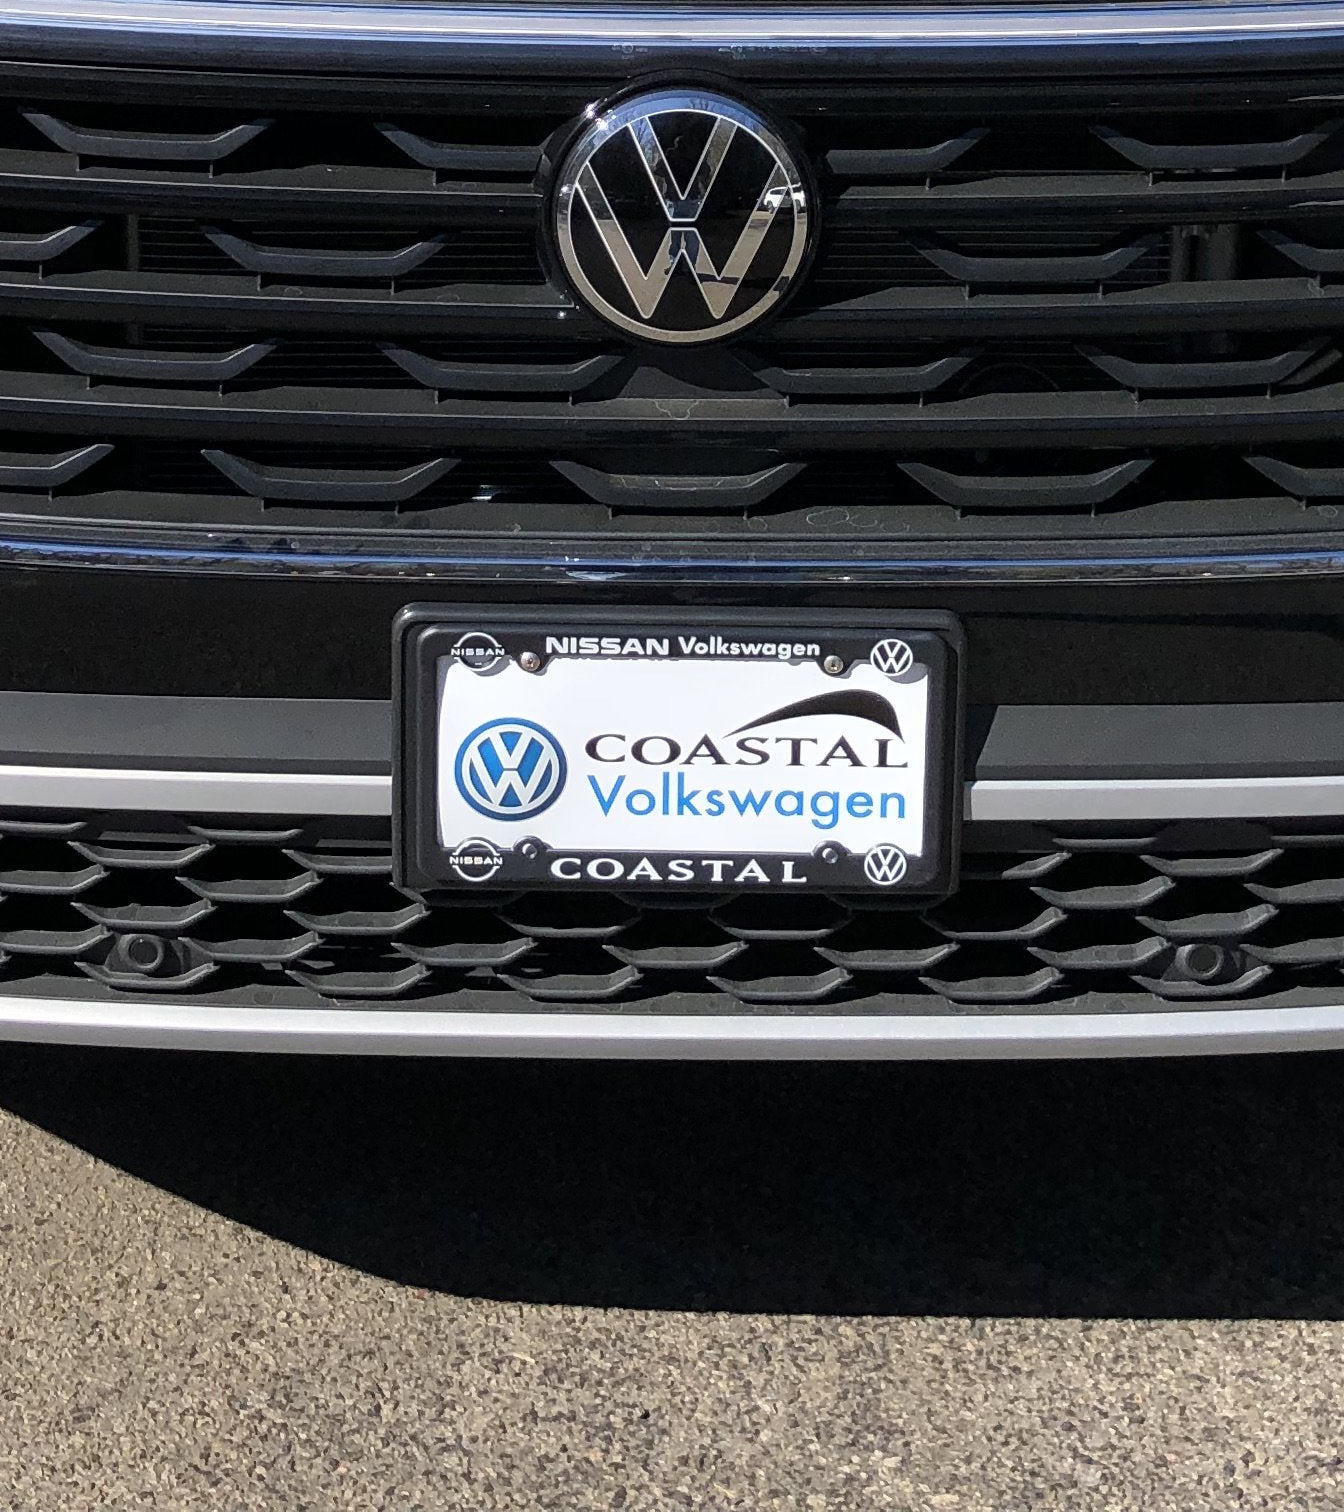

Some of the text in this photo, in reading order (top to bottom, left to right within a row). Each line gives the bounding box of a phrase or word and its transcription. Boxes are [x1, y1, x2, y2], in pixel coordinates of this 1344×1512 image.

[450, 647, 505, 657] NISSAN
[545, 636, 821, 660] NISSAN Volkswagen
[584, 733, 908, 768] COASTAL
[587, 771, 907, 830] Volkswagen
[449, 855, 503, 866] NISSAN
[550, 857, 808, 883] COASTAL
